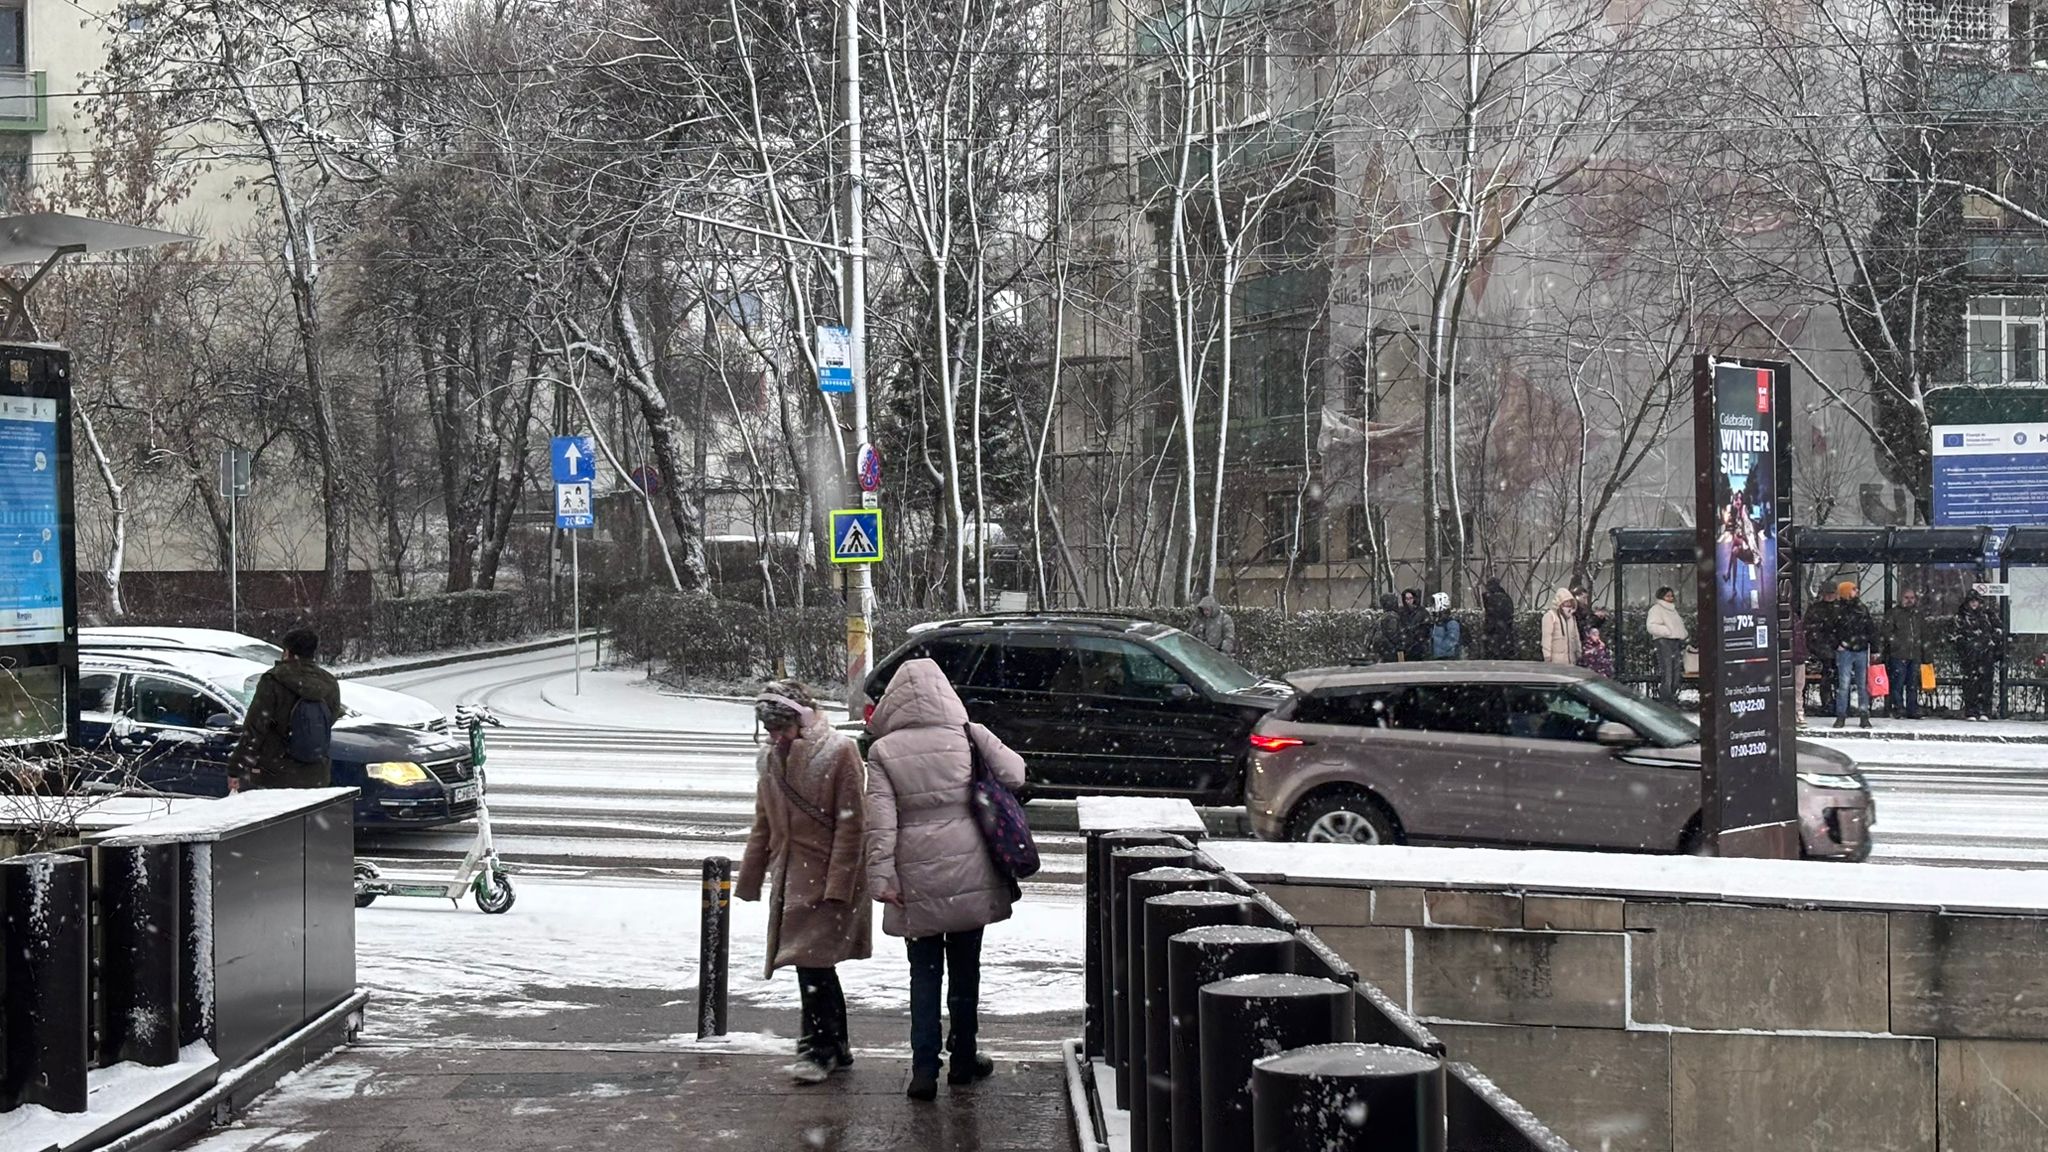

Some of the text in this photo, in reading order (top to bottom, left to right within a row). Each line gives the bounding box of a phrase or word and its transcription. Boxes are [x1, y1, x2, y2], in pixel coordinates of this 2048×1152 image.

[1720, 413, 1753, 429] Celebrating
[1720, 429, 1769, 452] WINTER
[1720, 453, 1750, 475] SALE
[1737, 615, 1754, 630] 70%
[1730, 699, 1765, 713] 10:00-22:00
[1730, 742, 1767, 757] 07:00-23:00
